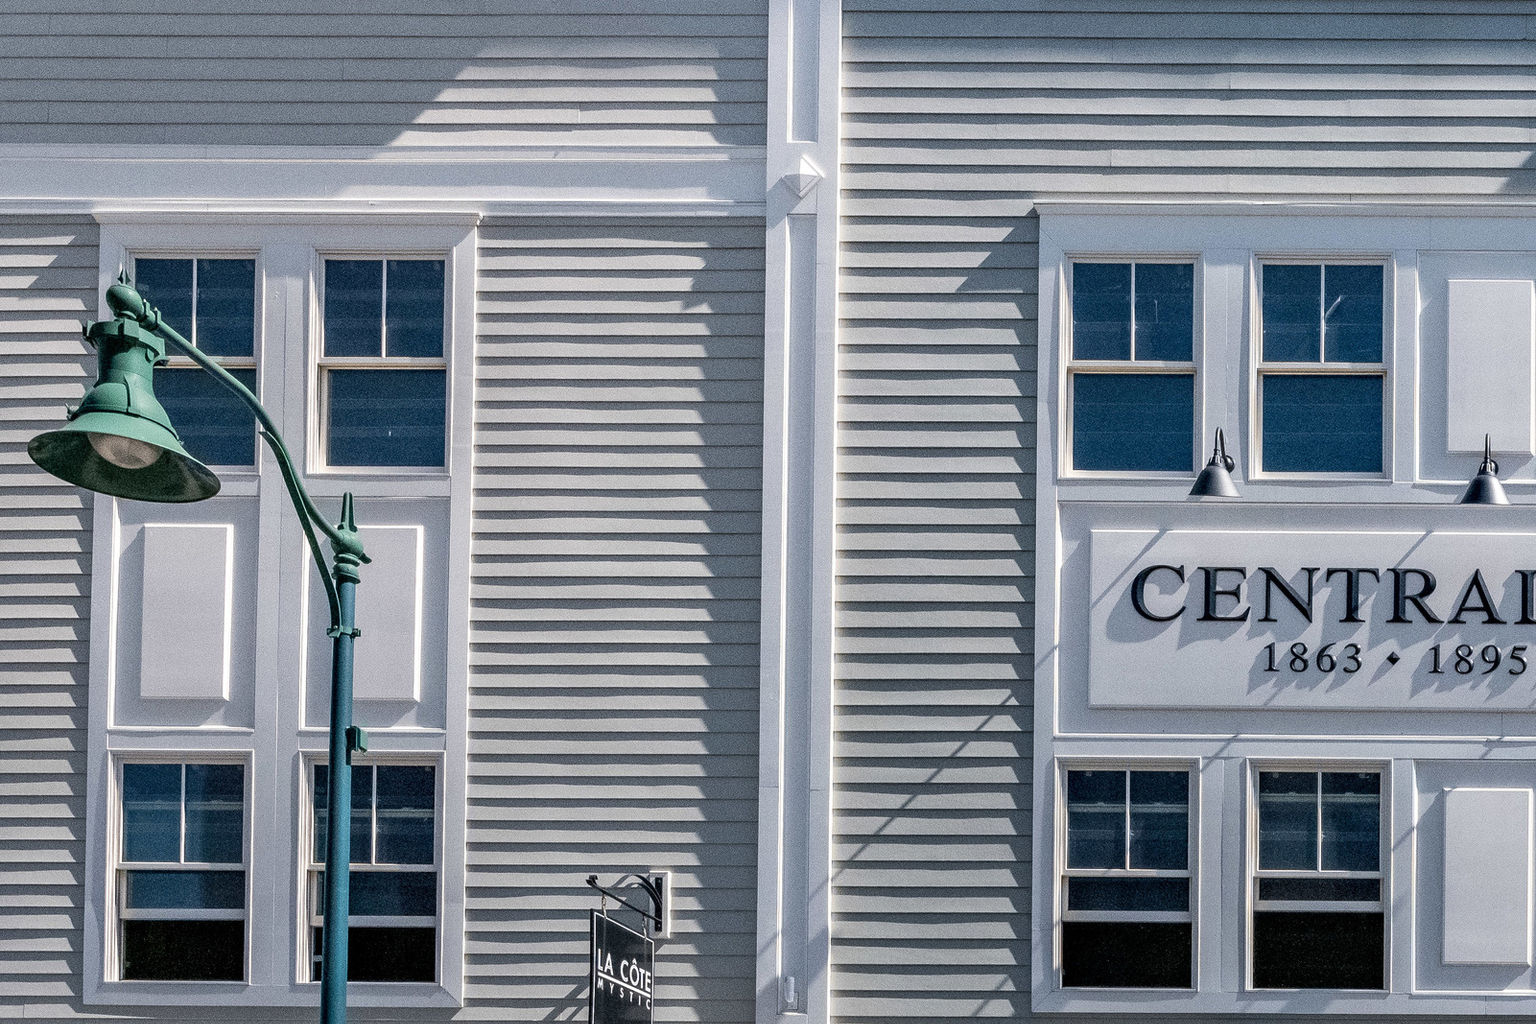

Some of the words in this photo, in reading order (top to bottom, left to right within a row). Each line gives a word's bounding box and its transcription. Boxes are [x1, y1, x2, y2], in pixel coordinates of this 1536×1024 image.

[1264, 642, 1362, 674] 1863
[1430, 644, 1527, 676] 1895
[598, 948, 614, 976] LA
[620, 958, 651, 993] CÔTE
[597, 978, 651, 1010] MYSTIC
